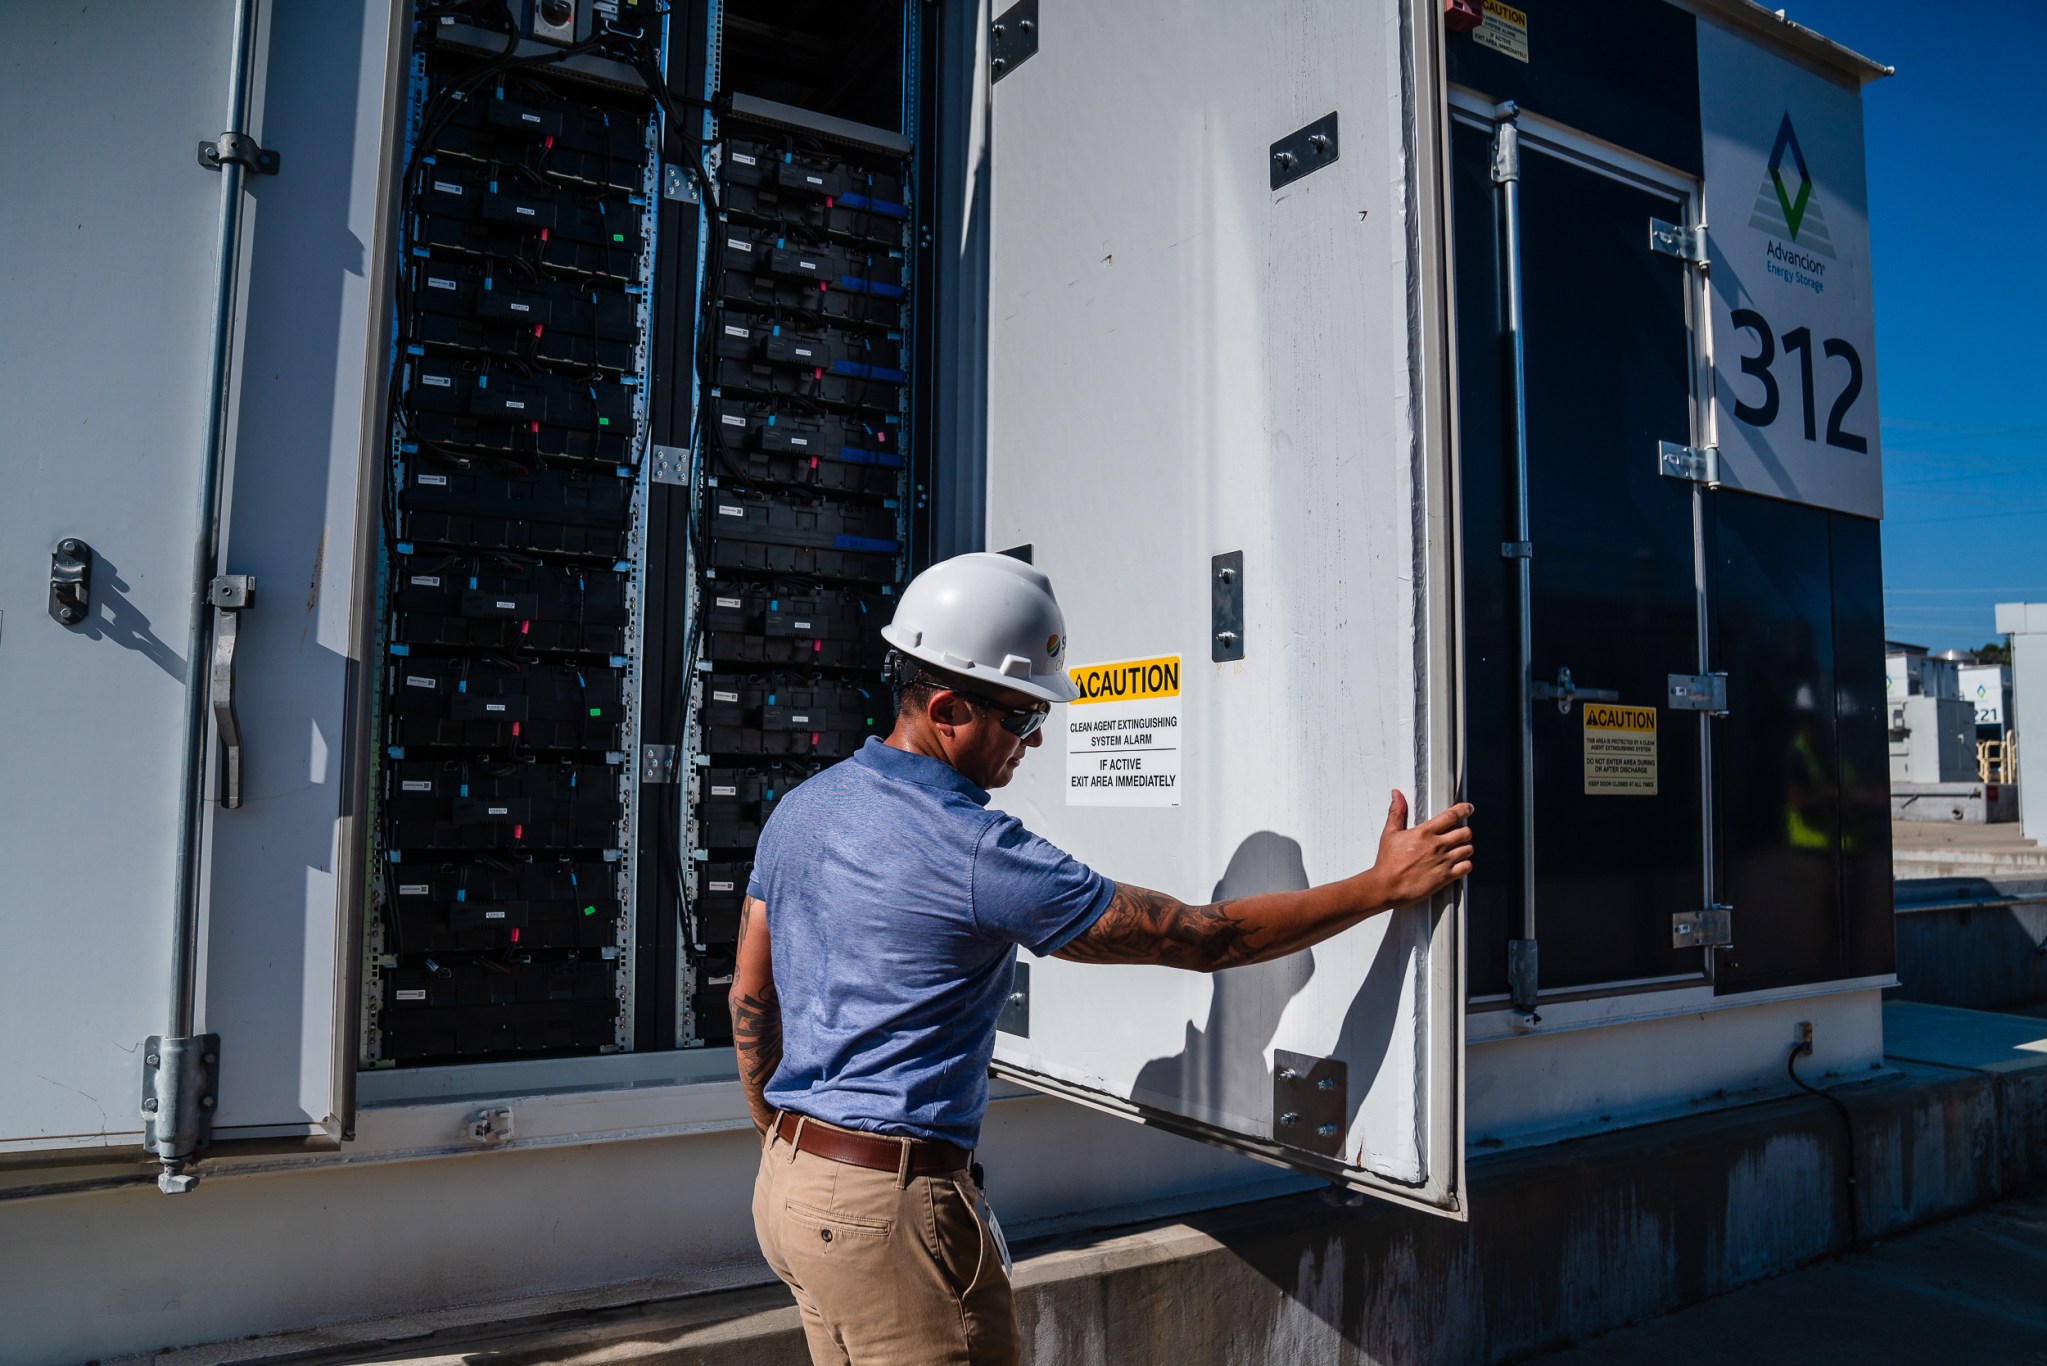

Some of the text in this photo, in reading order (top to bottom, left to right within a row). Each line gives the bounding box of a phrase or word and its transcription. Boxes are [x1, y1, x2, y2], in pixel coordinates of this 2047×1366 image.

[1483, 0, 1525, 25] CAUTION
[1495, 35, 1511, 46] ACTIVE
[1767, 262, 1824, 294] Energy Storage
[1730, 308, 1867, 454] 312
[1088, 662, 1178, 698] CAUTION
[1070, 716, 1177, 732] CLEAN AGENT EXTINGUISHING
[1598, 710, 1654, 728] CAUTION
[1091, 734, 1152, 746] SYSTEM ALARM
[1100, 758, 1141, 770] IF ACTIVE
[1071, 775, 1176, 787] EXIT AREA IMMEDIATELY
